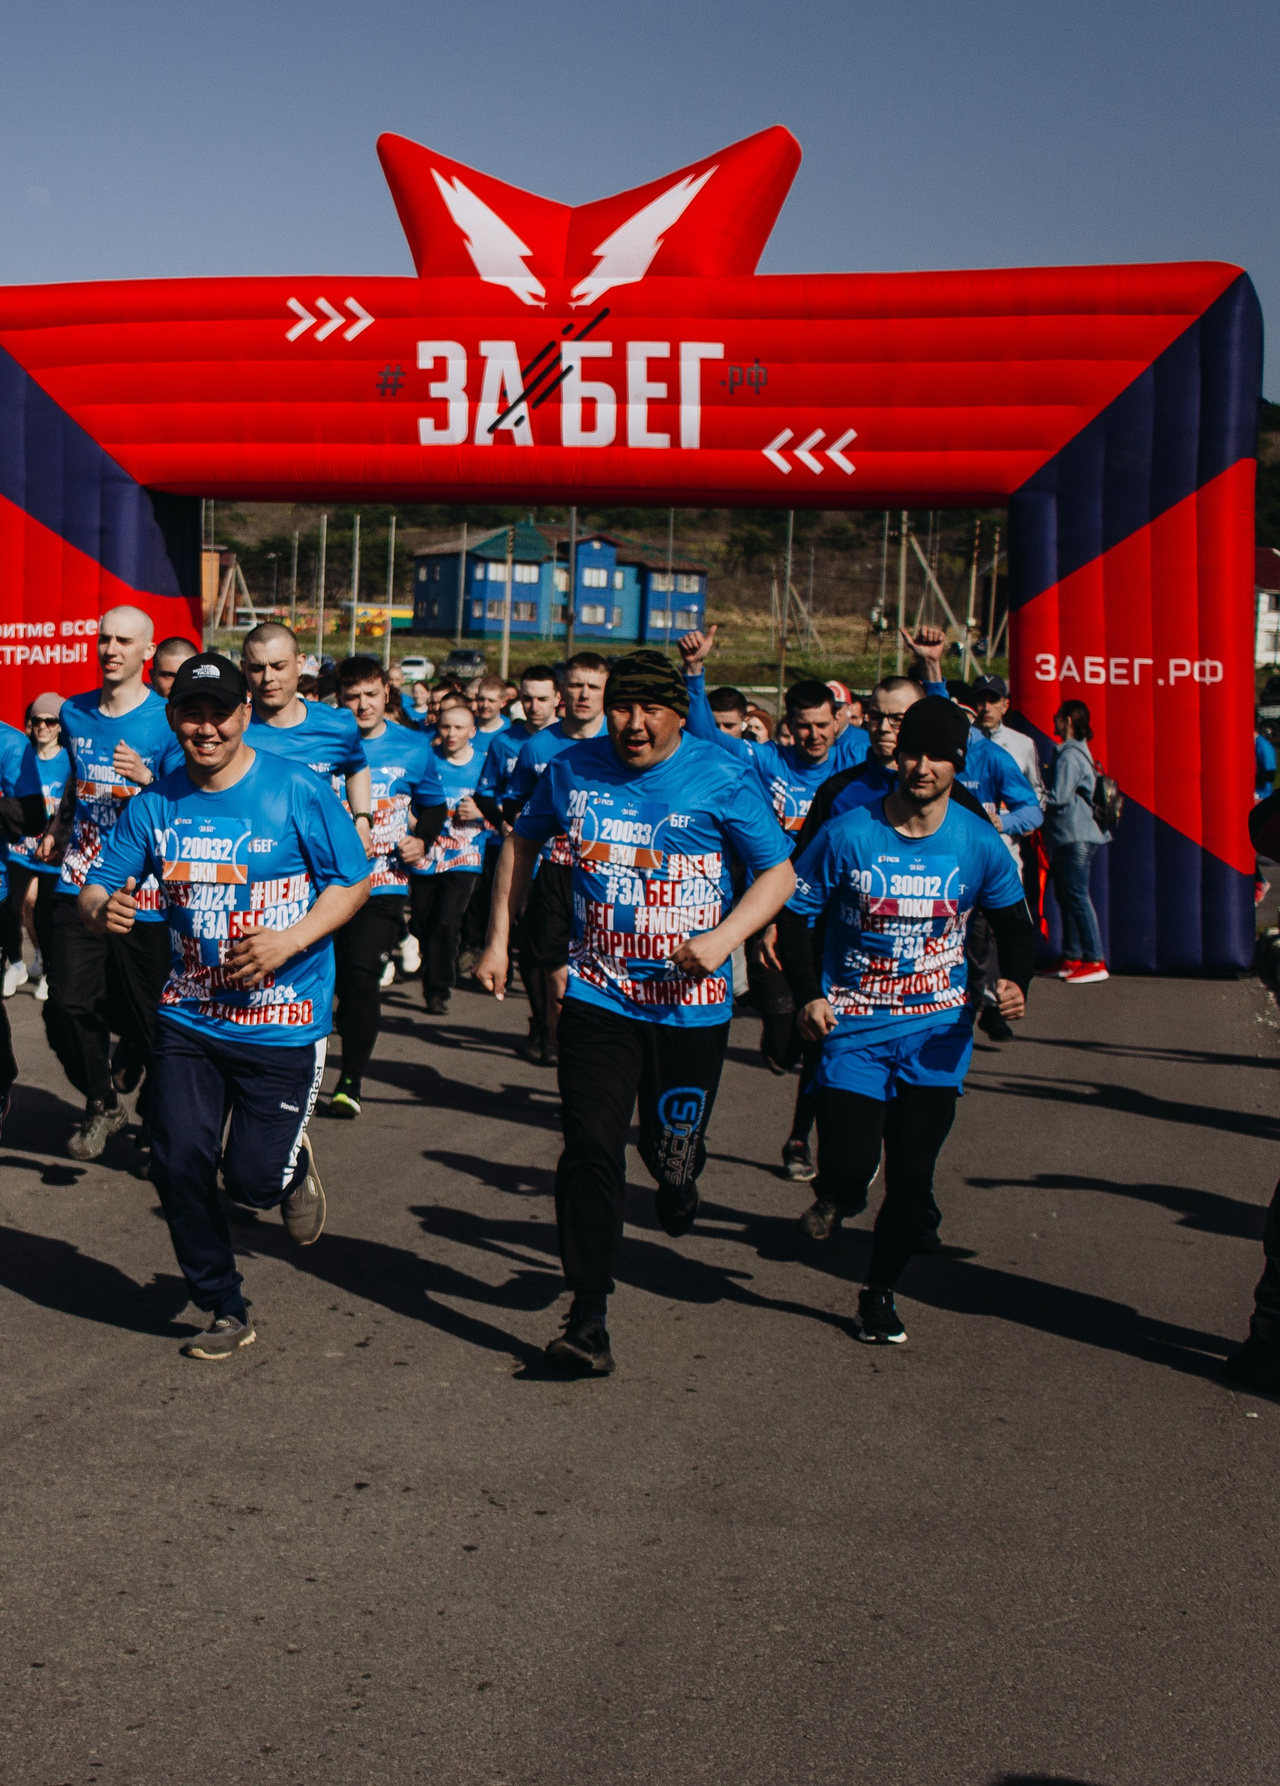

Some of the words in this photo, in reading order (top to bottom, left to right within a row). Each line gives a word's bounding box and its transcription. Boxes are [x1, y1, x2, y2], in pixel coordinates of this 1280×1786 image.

[60, 617, 102, 637] все
[1034, 652, 1224, 687] ЗАБЕГ.РФ
[599, 817, 652, 846] 20033
[181, 836, 233, 861] 20032
[889, 873, 942, 898] 30012
